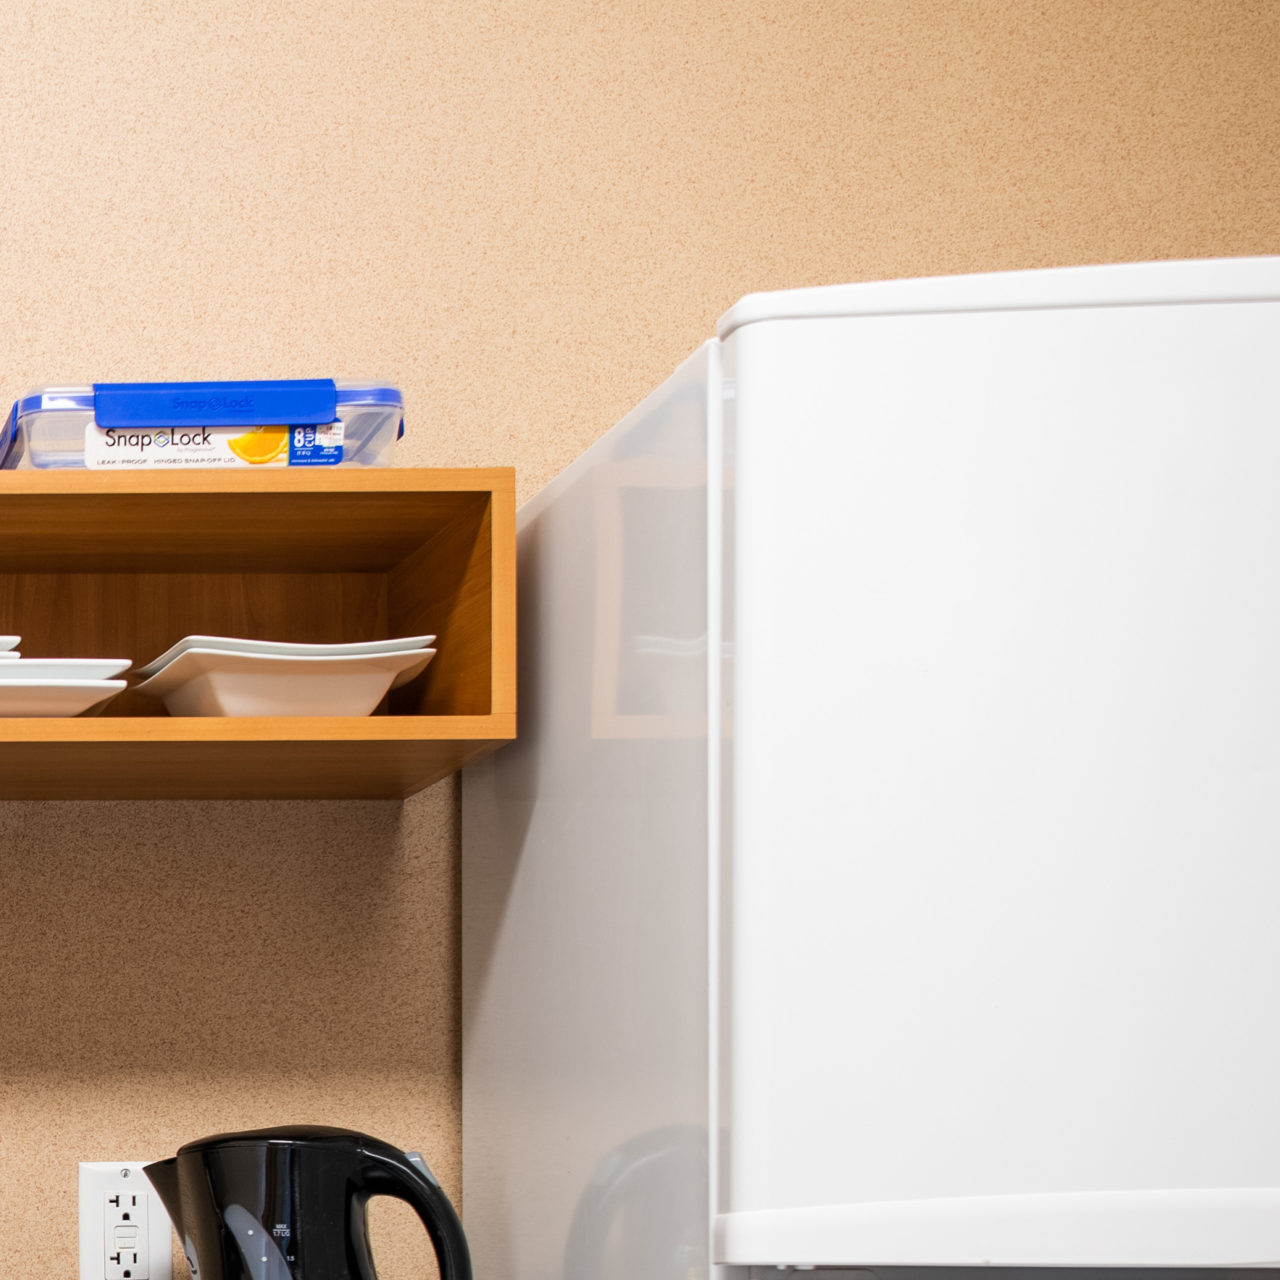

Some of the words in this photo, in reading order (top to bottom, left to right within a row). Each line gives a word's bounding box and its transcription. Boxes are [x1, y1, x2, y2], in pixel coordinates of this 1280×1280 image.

[105, 428, 152, 452] Snap
[171, 427, 211, 446] Lock
[294, 428, 304, 448] 8
[305, 427, 314, 447] CUP
